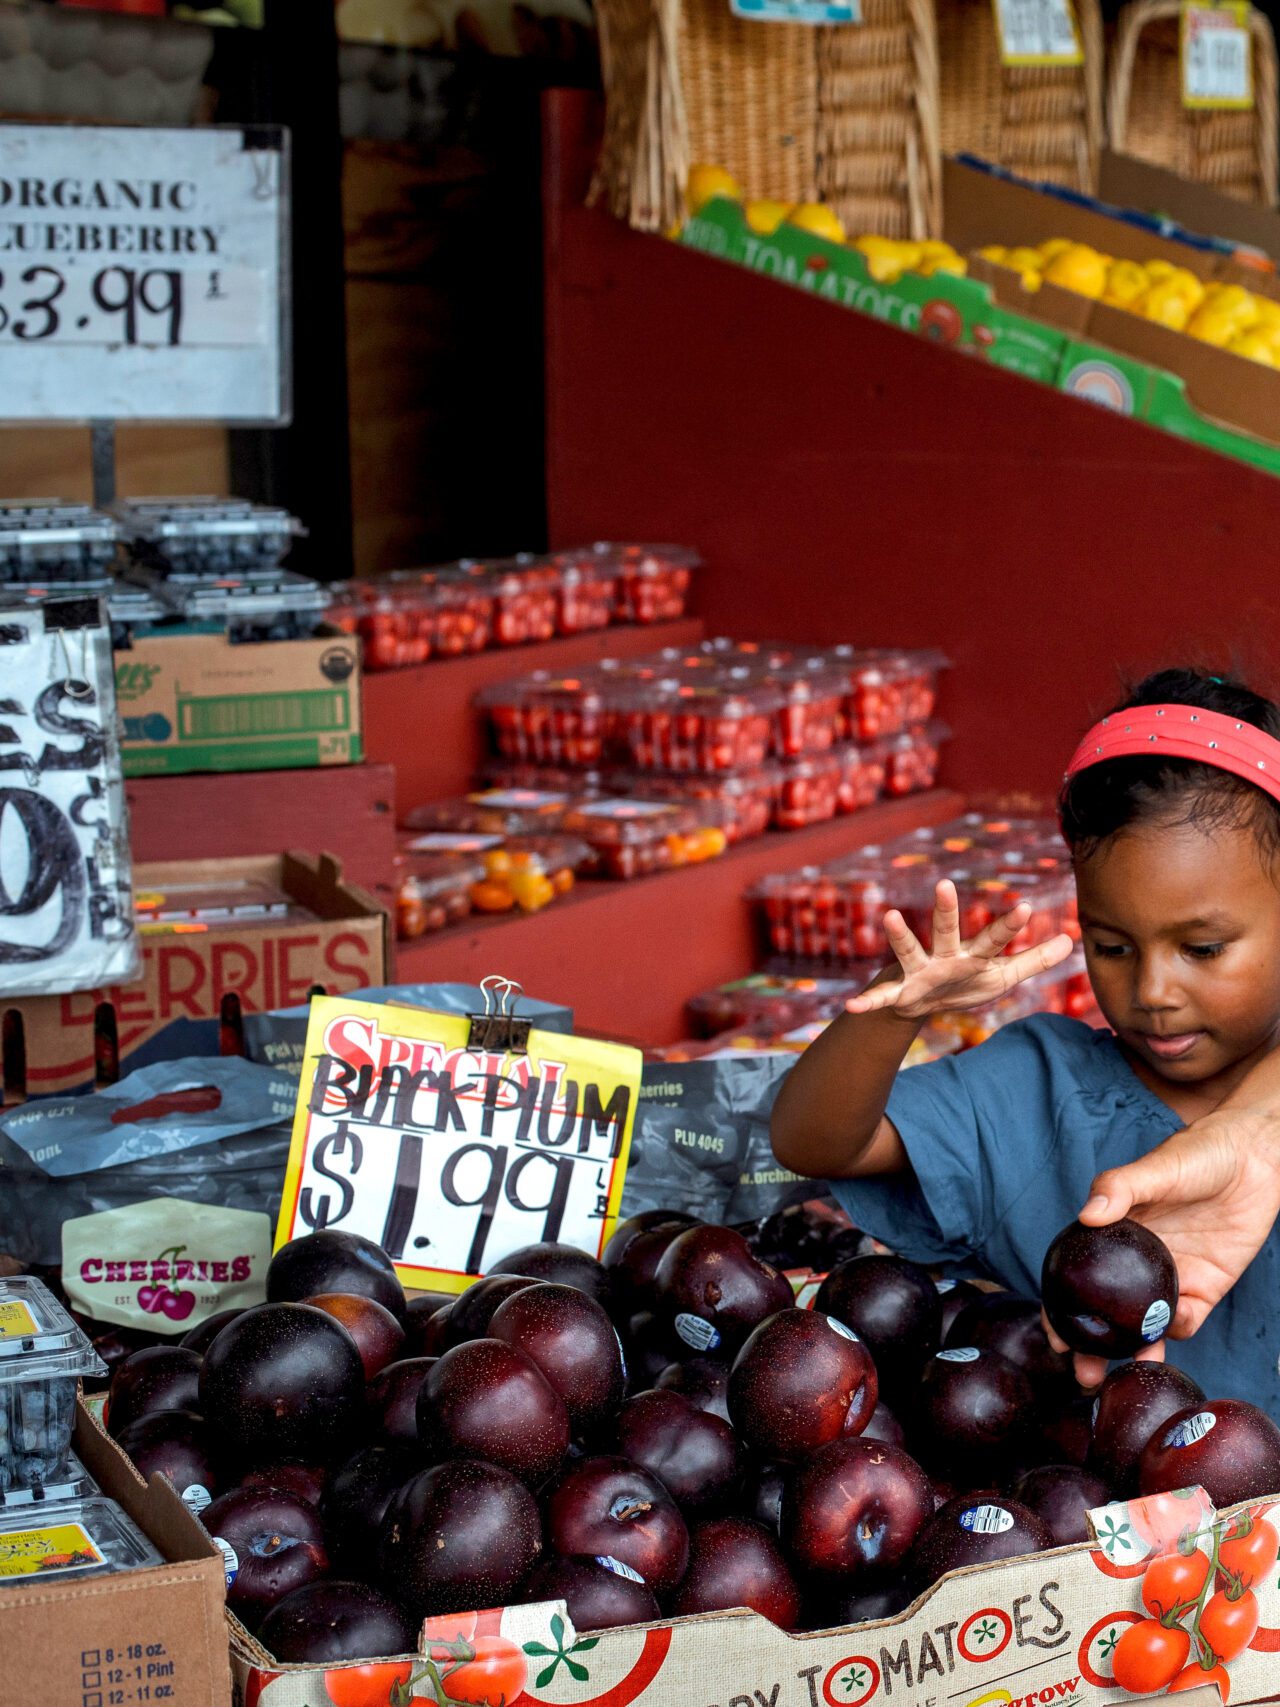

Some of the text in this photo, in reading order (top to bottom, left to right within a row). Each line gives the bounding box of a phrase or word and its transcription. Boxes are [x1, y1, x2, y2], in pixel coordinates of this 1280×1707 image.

[0, 265, 182, 347] 3.99
[314, 1016, 567, 1108] SPECIAL
[307, 1055, 631, 1158] BLACK PLUM
[674, 1128, 725, 1155] PLU 4045
[299, 1119, 576, 1276] $1.99
[80, 1255, 251, 1283] CHERRIES
[105, 1648, 115, 1663] 8
[127, 1644, 142, 1659] 18
[146, 1643, 167, 1657] oz.
[797, 1581, 1071, 1707] TOMATOES
[107, 1669, 123, 1683] 12
[135, 1666, 142, 1680] 1
[146, 1661, 174, 1678] Pint
[108, 1690, 124, 1704] 12
[137, 1686, 150, 1700] 11
[155, 1685, 175, 1699] oz.
